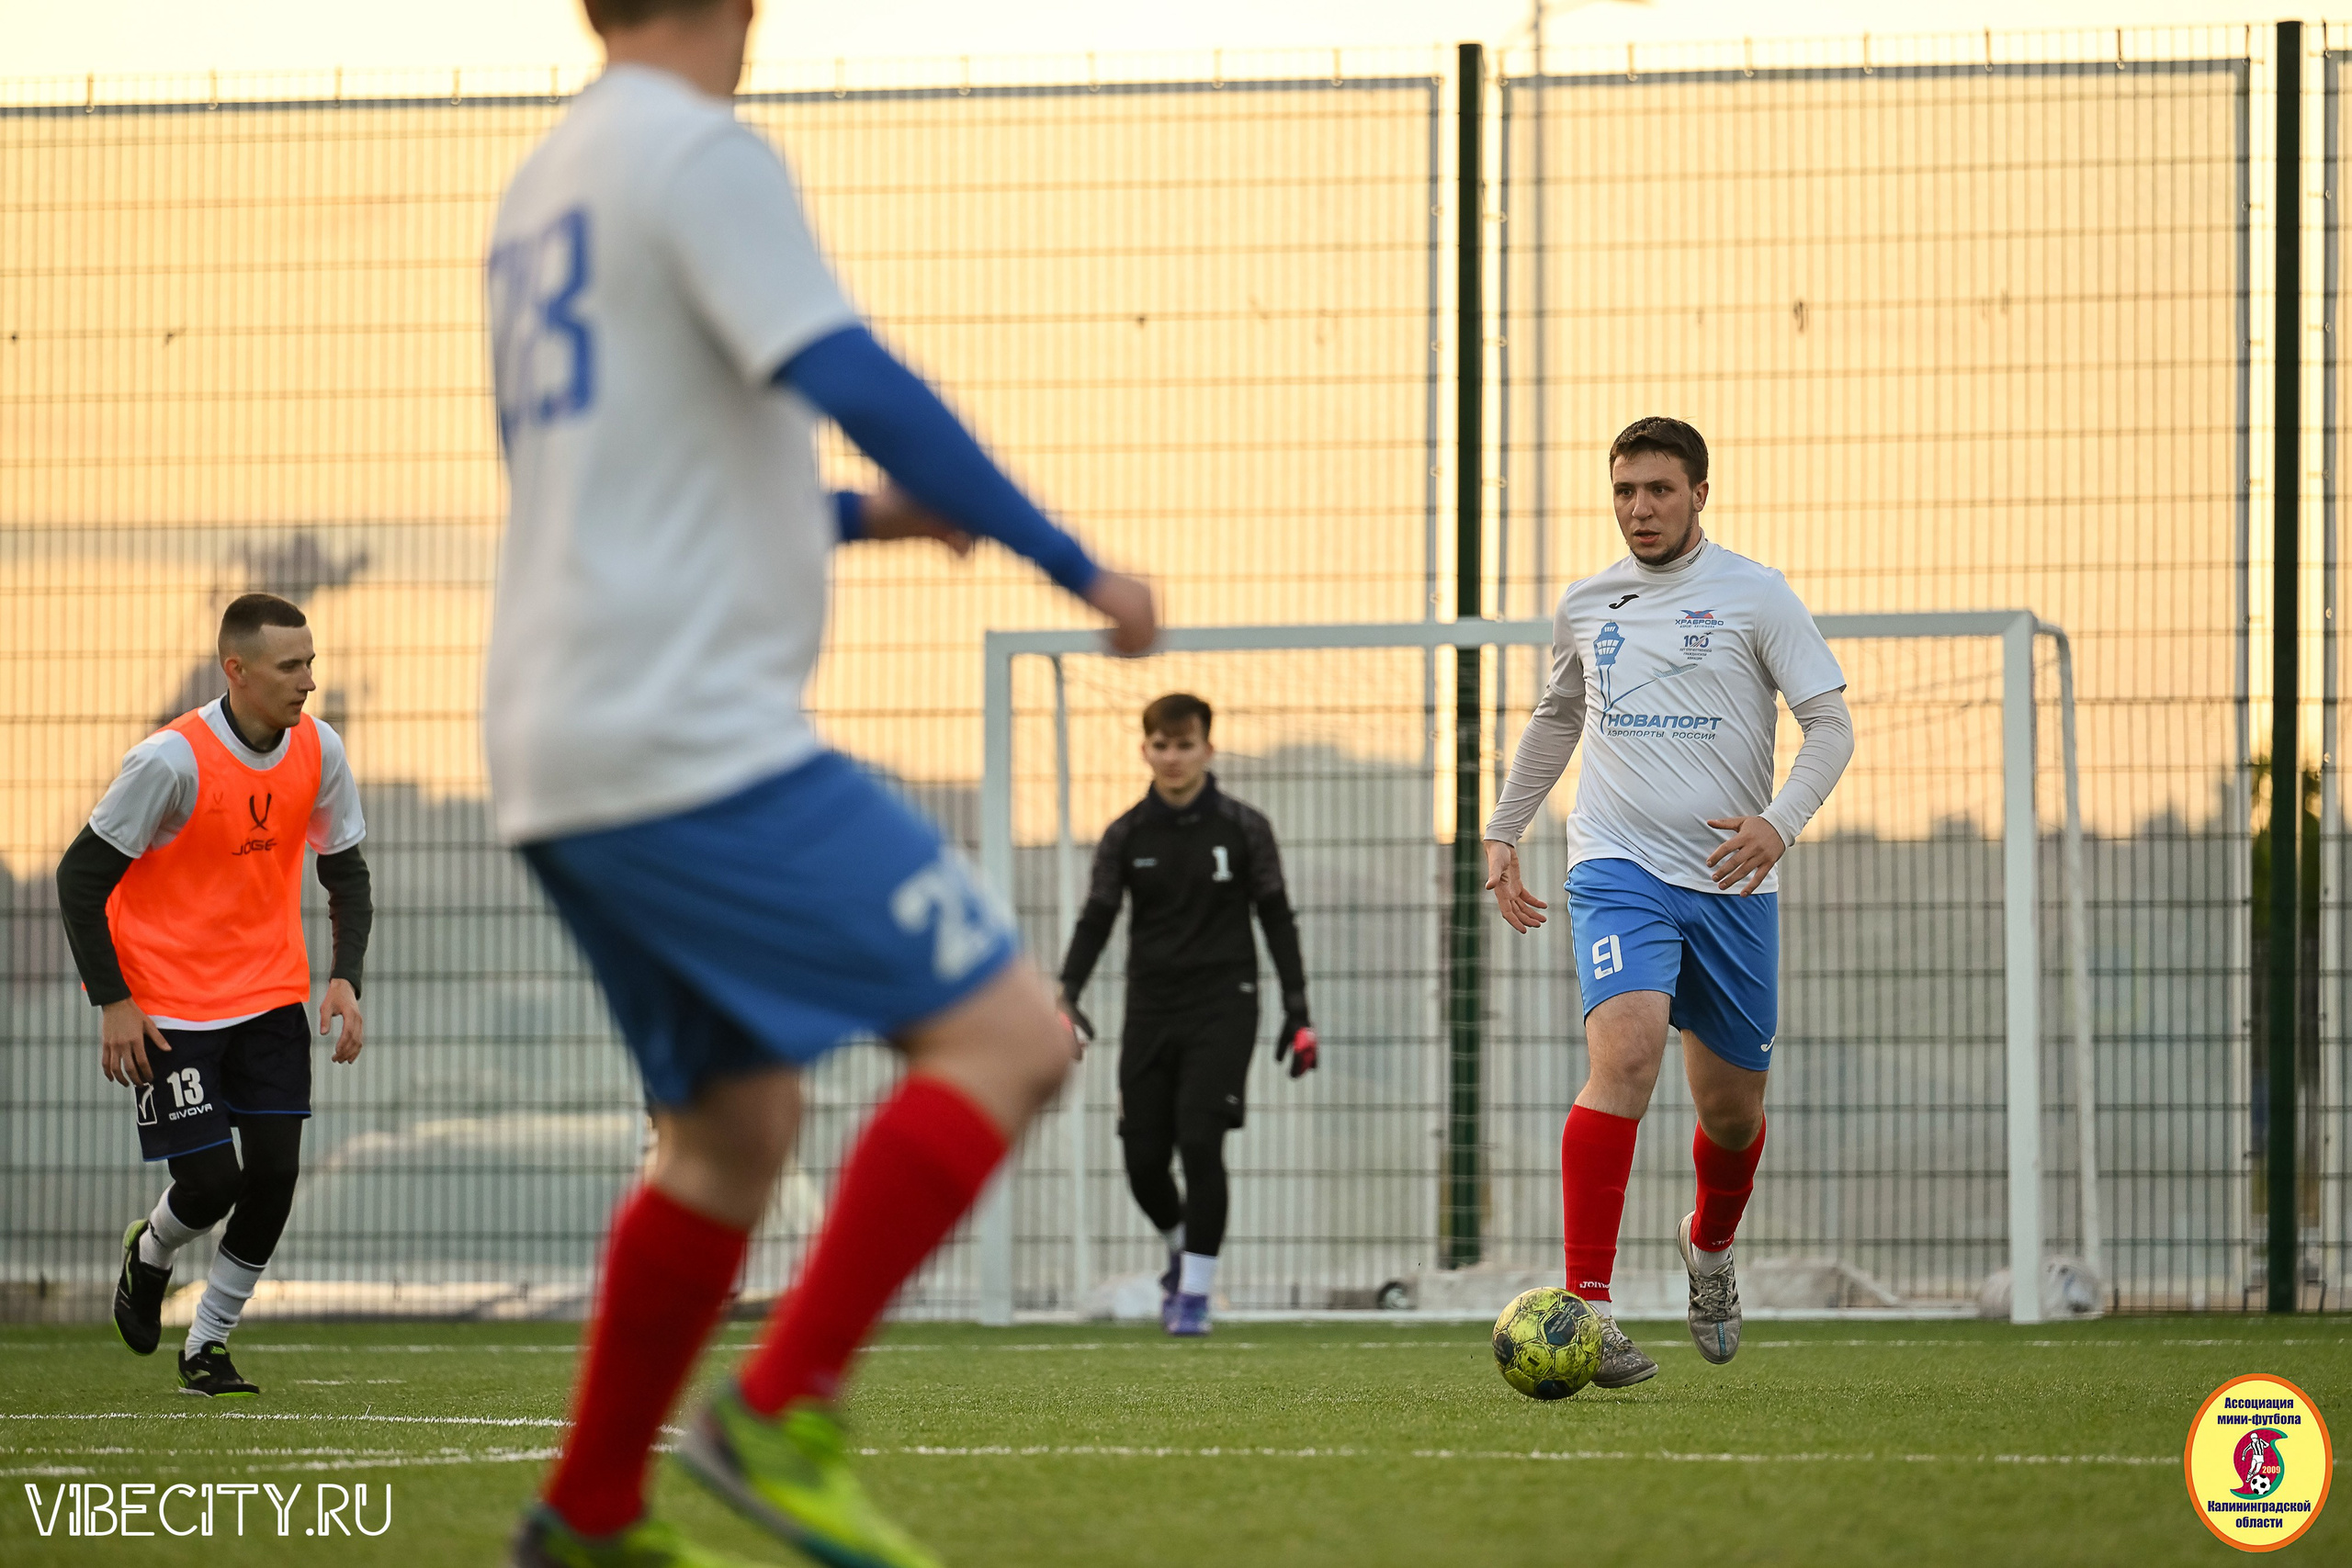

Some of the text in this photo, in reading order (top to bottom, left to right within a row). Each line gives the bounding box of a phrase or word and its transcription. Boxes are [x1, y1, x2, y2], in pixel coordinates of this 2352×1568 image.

[1683, 635, 1710, 649] 100
[1608, 714, 1723, 730] НОВАПОРТ
[1607, 729, 1716, 740] АЭРОПОРТЫ РОССИИ
[1212, 846, 1233, 882] 1
[1591, 934, 1623, 980] 9
[166, 1067, 204, 1108] 13
[168, 1103, 213, 1121] GIVOVA
